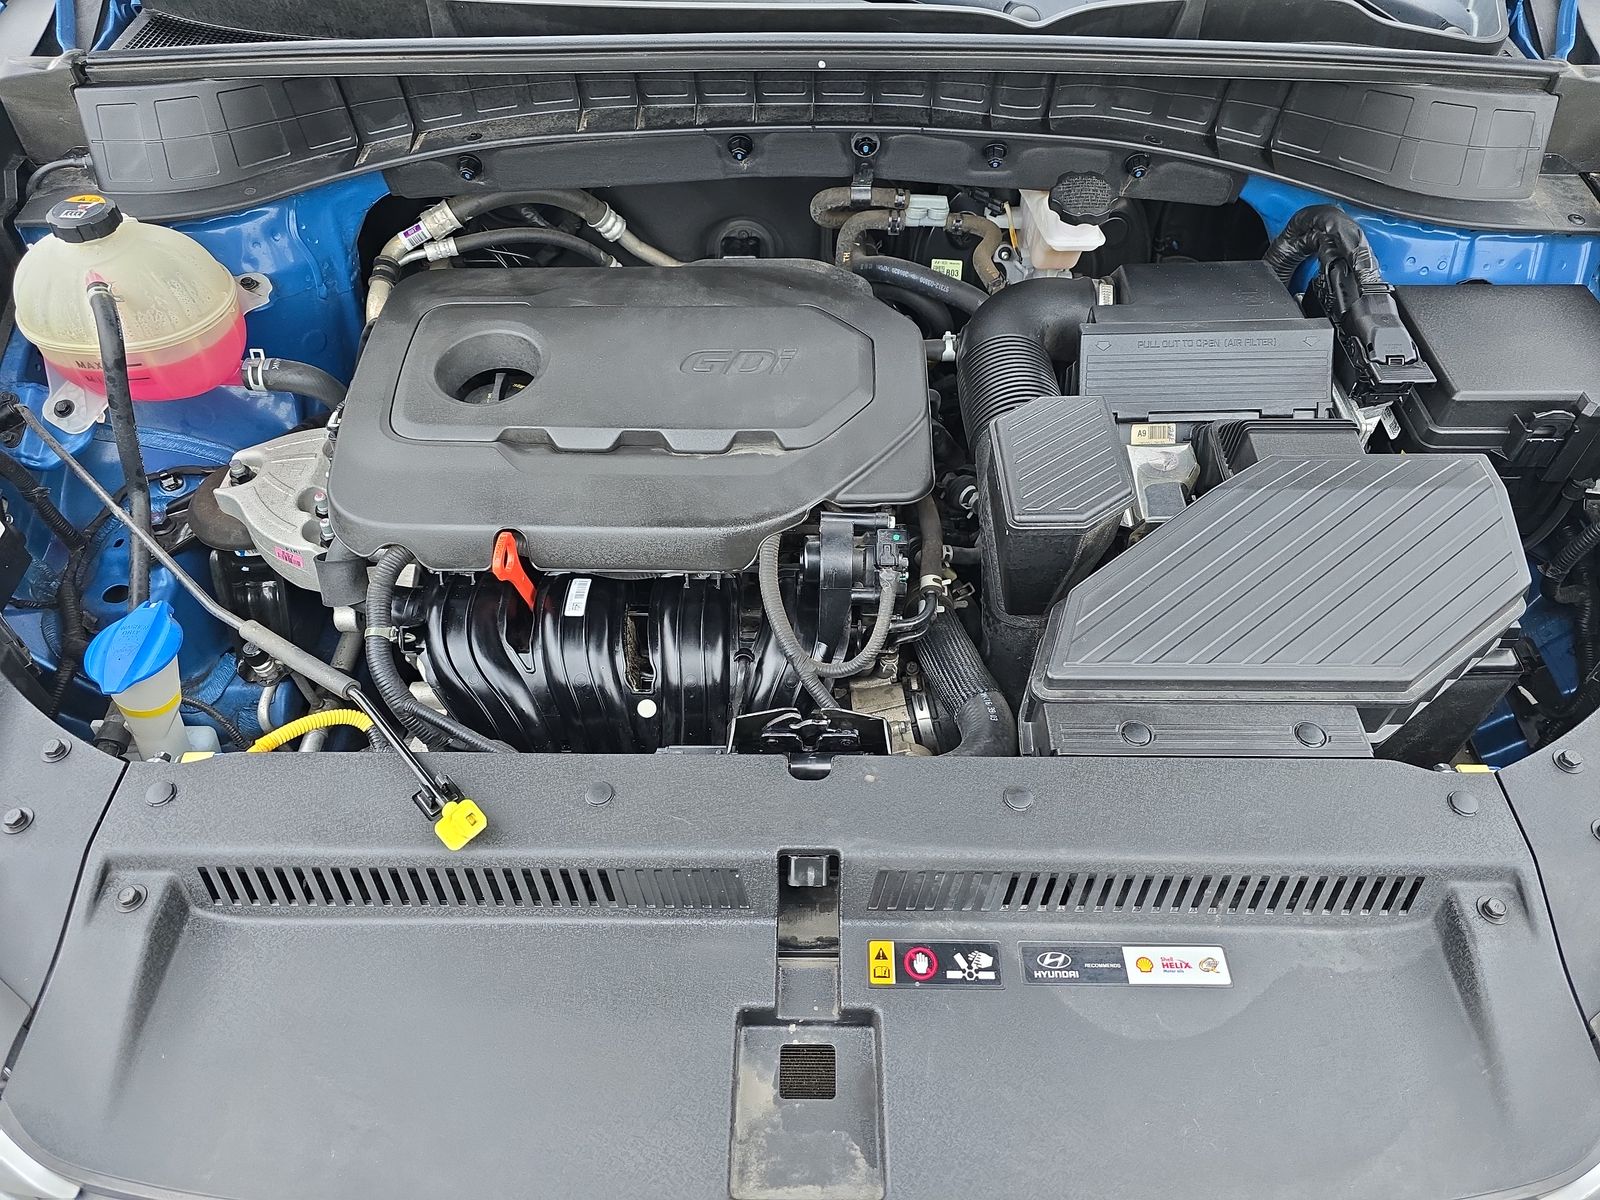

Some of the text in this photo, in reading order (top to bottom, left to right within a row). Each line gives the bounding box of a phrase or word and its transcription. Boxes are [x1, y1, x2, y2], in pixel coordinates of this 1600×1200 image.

[1137, 340, 1160, 349] PULL
[1161, 340, 1180, 348] OUT
[1181, 339, 1194, 348] TO
[1195, 339, 1220, 348] OPEN
[75, 361, 103, 369] MAX
[1137, 429, 1147, 438] A9
[1034, 970, 1080, 979] HYUNDAI
